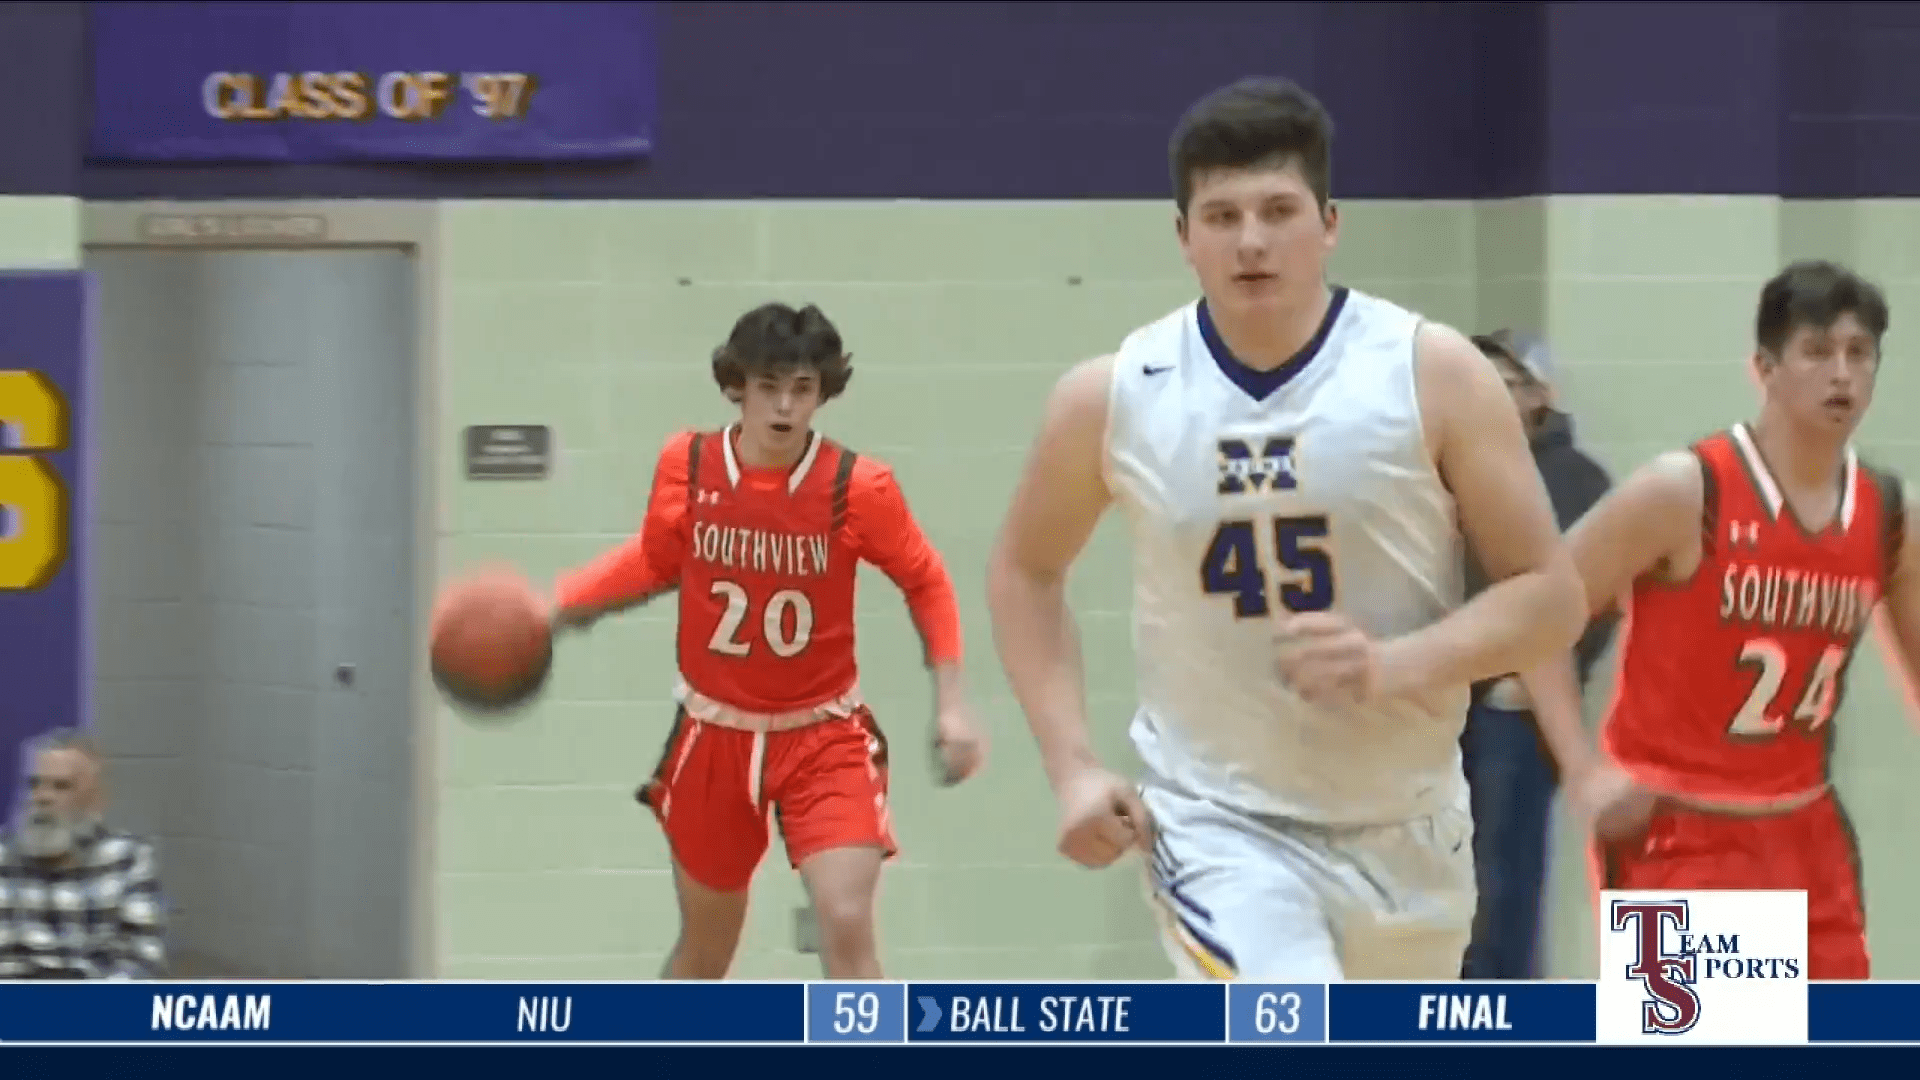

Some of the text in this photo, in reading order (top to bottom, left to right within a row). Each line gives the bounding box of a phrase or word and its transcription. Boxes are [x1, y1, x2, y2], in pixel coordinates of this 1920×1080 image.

[202, 70, 376, 121] CLASS
[377, 70, 452, 121] OF
[692, 520, 830, 576] SOUTHVIEW
[1201, 514, 1336, 620] 45
[707, 580, 815, 658] 20
[1728, 638, 1846, 735] 24
